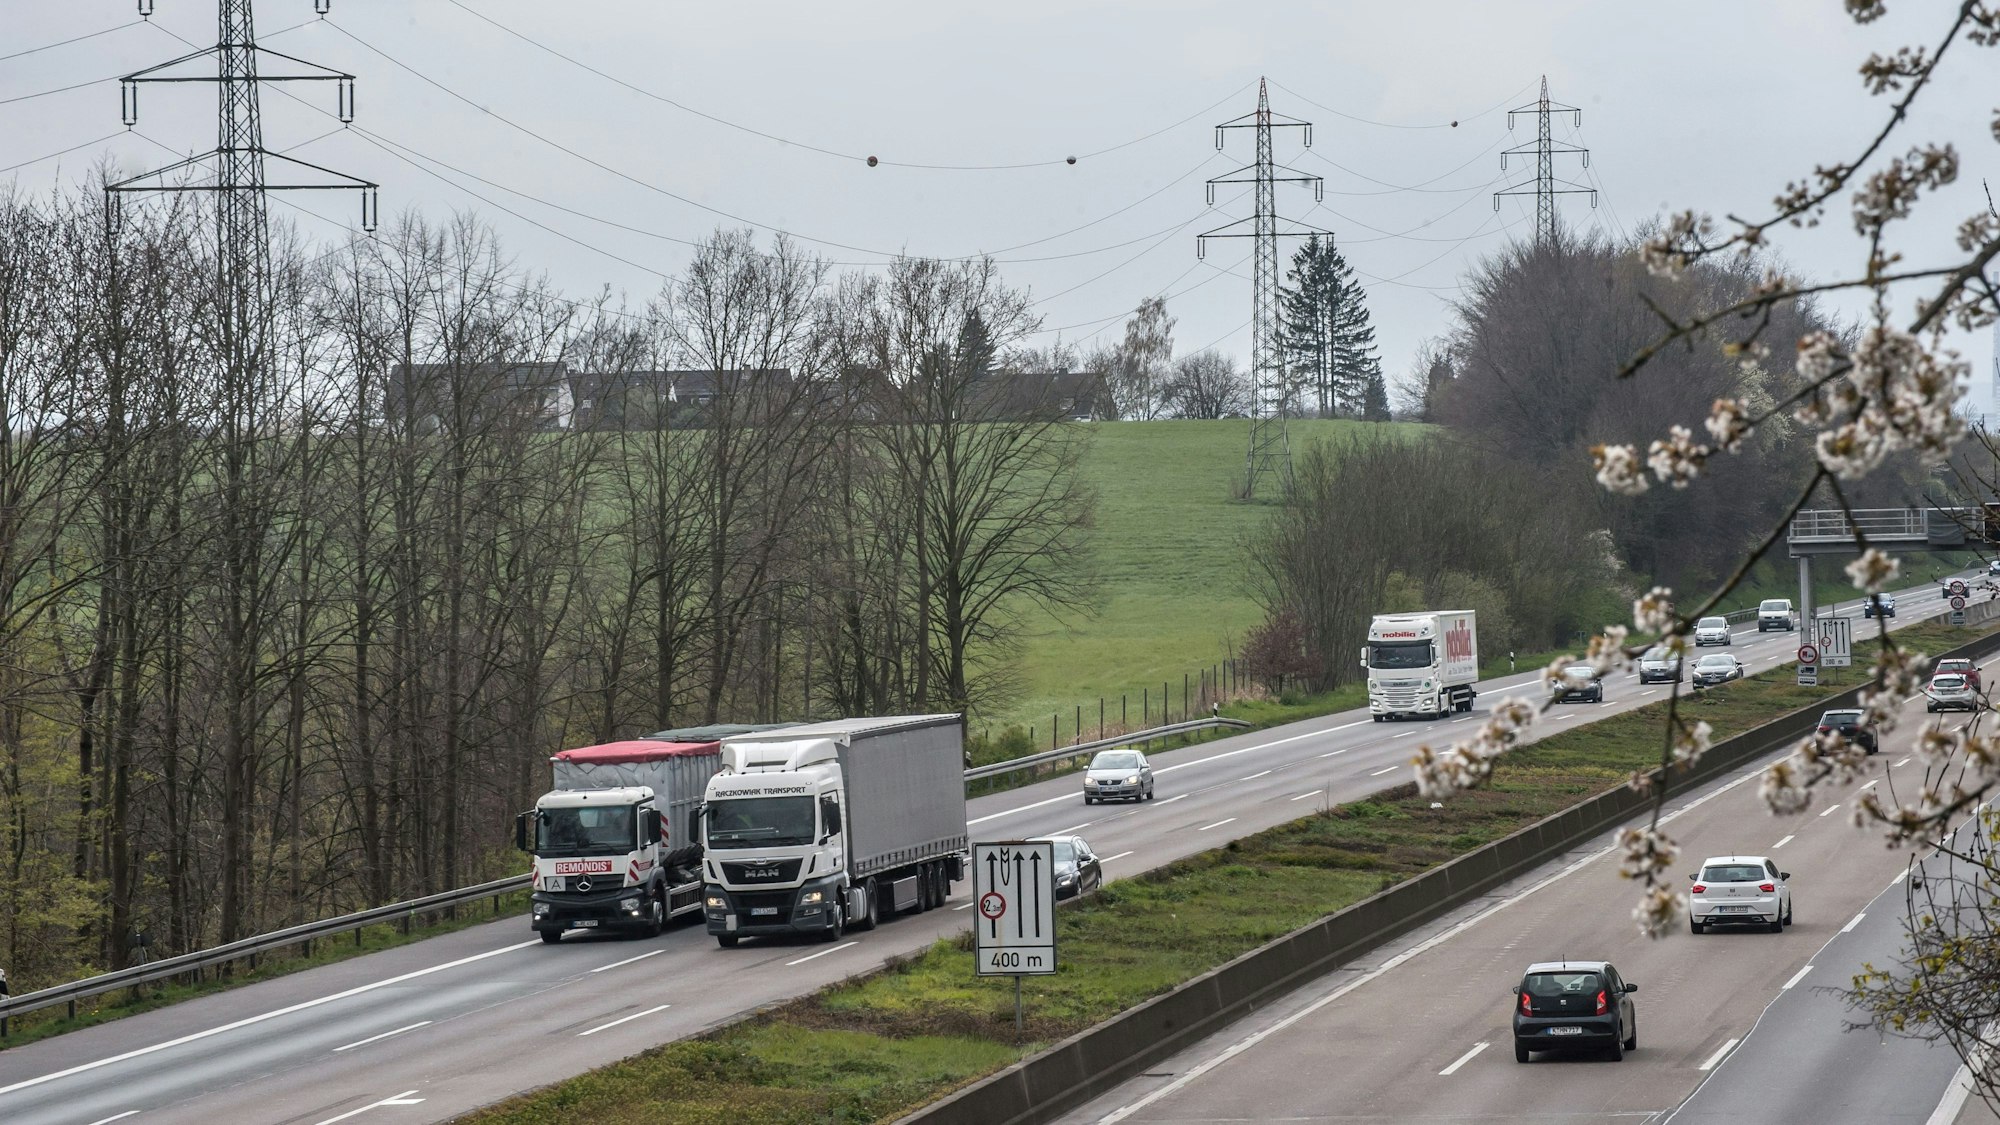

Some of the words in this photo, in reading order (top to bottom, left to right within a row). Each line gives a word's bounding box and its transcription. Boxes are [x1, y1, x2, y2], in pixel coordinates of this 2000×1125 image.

[715, 788, 761, 798] RACZKOWIAK
[763, 786, 807, 795] TRANSPORT
[556, 861, 608, 873] REMONDIS
[744, 868, 780, 878] MAN
[550, 879, 562, 890] A
[991, 952, 1020, 968] 400
[1027, 955, 1042, 967] m
